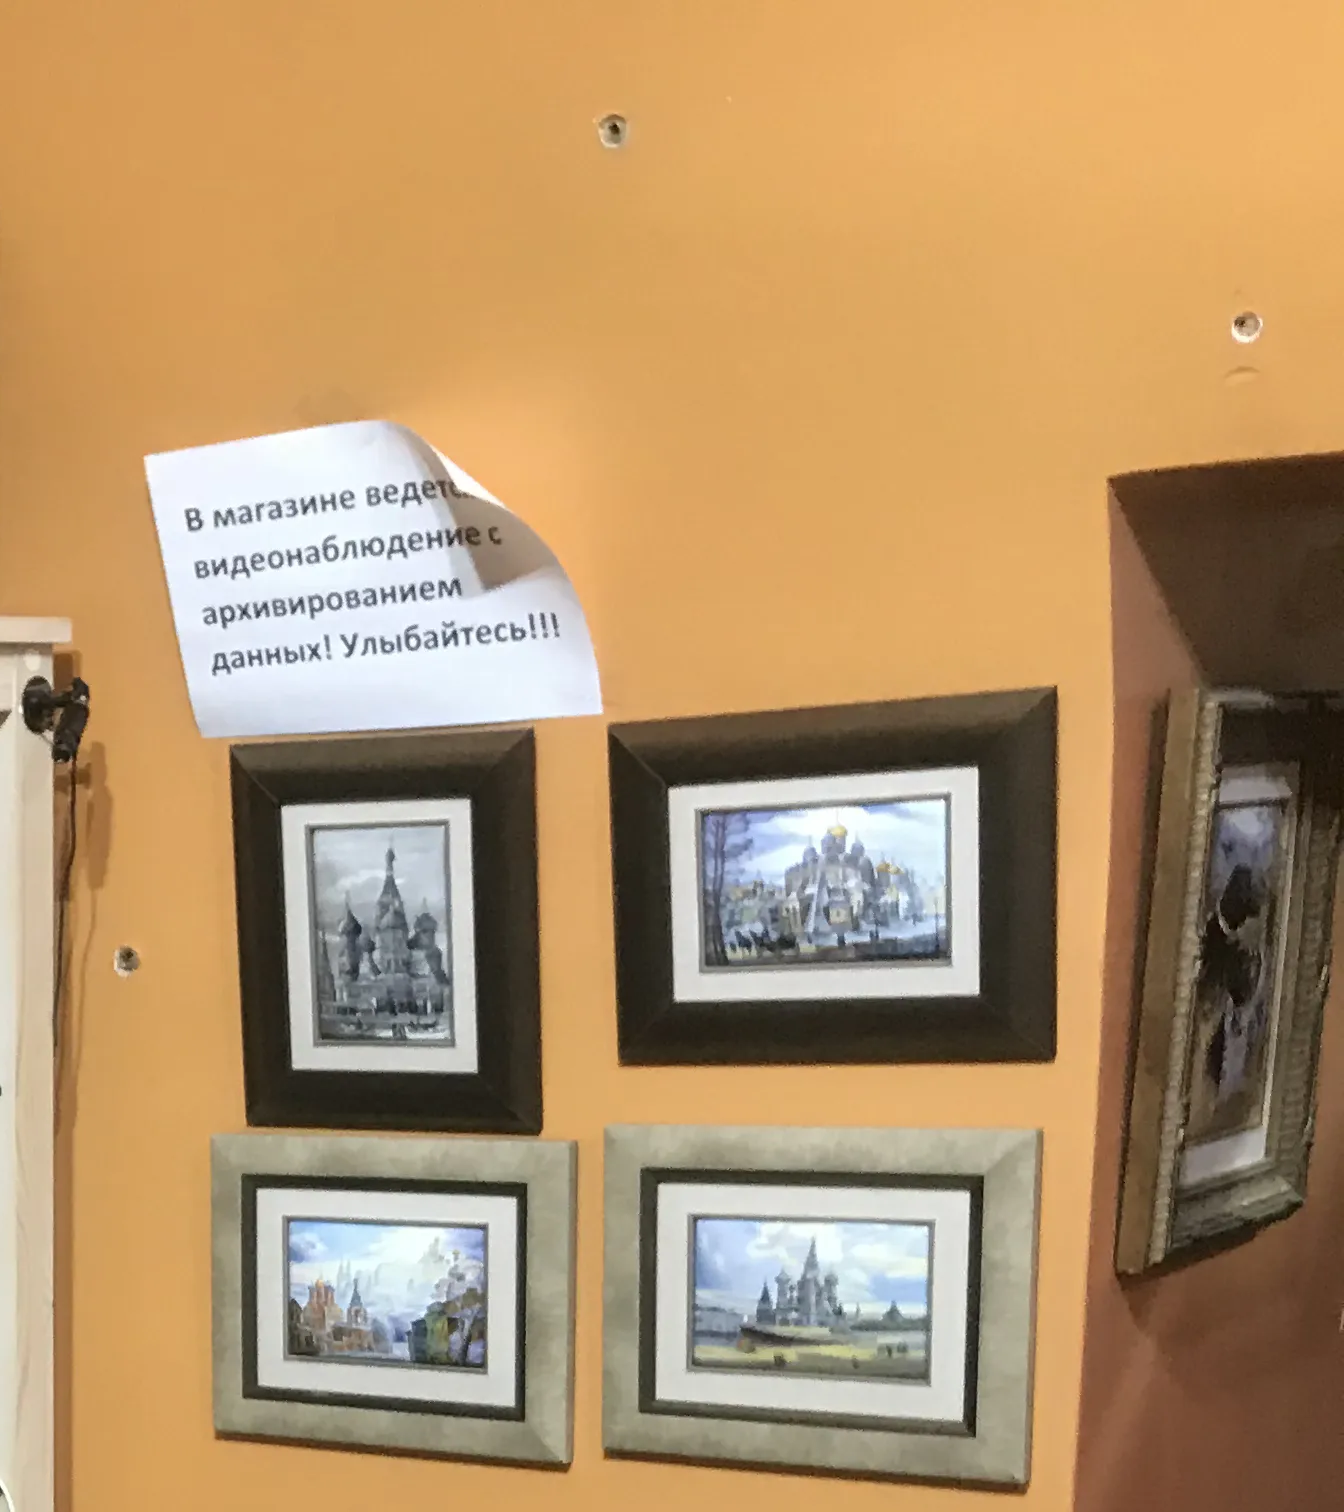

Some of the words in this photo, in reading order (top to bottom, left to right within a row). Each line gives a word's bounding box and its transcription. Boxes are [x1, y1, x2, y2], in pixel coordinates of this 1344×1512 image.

[185, 507, 203, 532] В
[214, 490, 355, 528] магазине
[365, 479, 469, 508] ведетс
[195, 527, 480, 580] видеонаблюдение
[488, 526, 502, 545] с
[203, 577, 462, 630] архивированием
[212, 635, 332, 676] данных!
[340, 613, 560, 660] Улыбайтесь!!!
